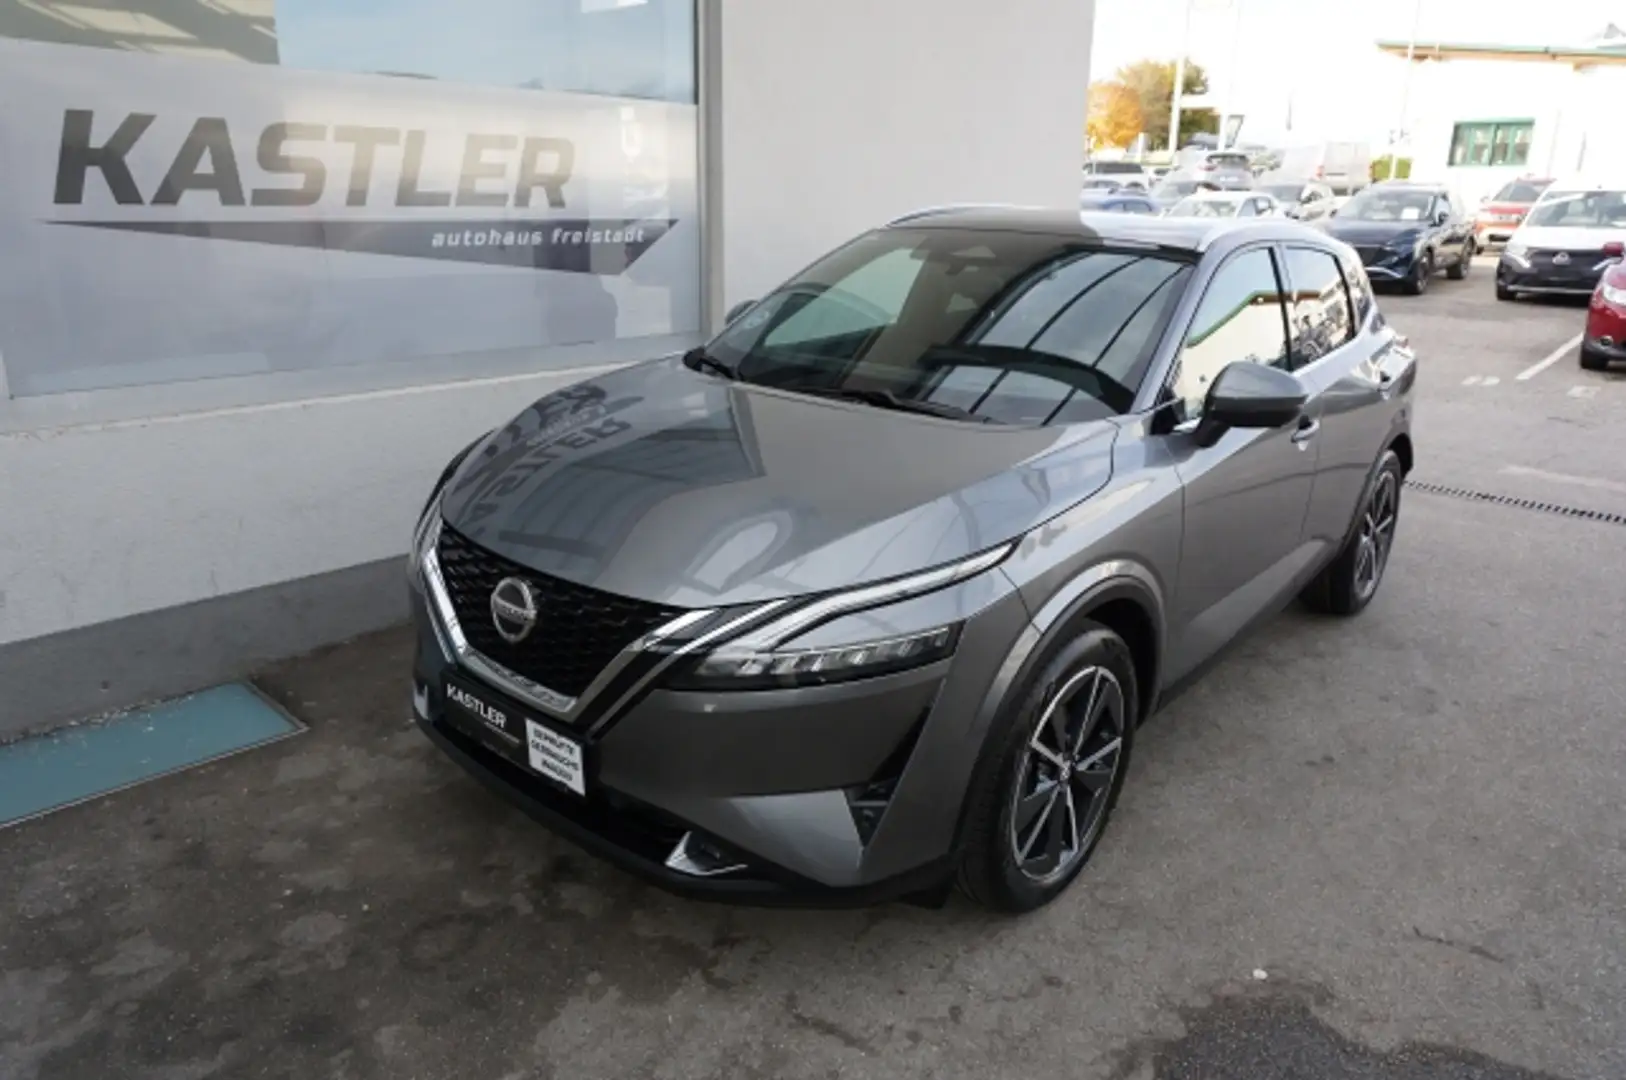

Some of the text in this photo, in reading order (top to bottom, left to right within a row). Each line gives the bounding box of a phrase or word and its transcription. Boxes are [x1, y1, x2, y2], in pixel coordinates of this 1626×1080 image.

[52, 109, 576, 208] KASTLER
[431, 226, 646, 248] autohaus freistadt
[447, 683, 507, 728] KASTLER
